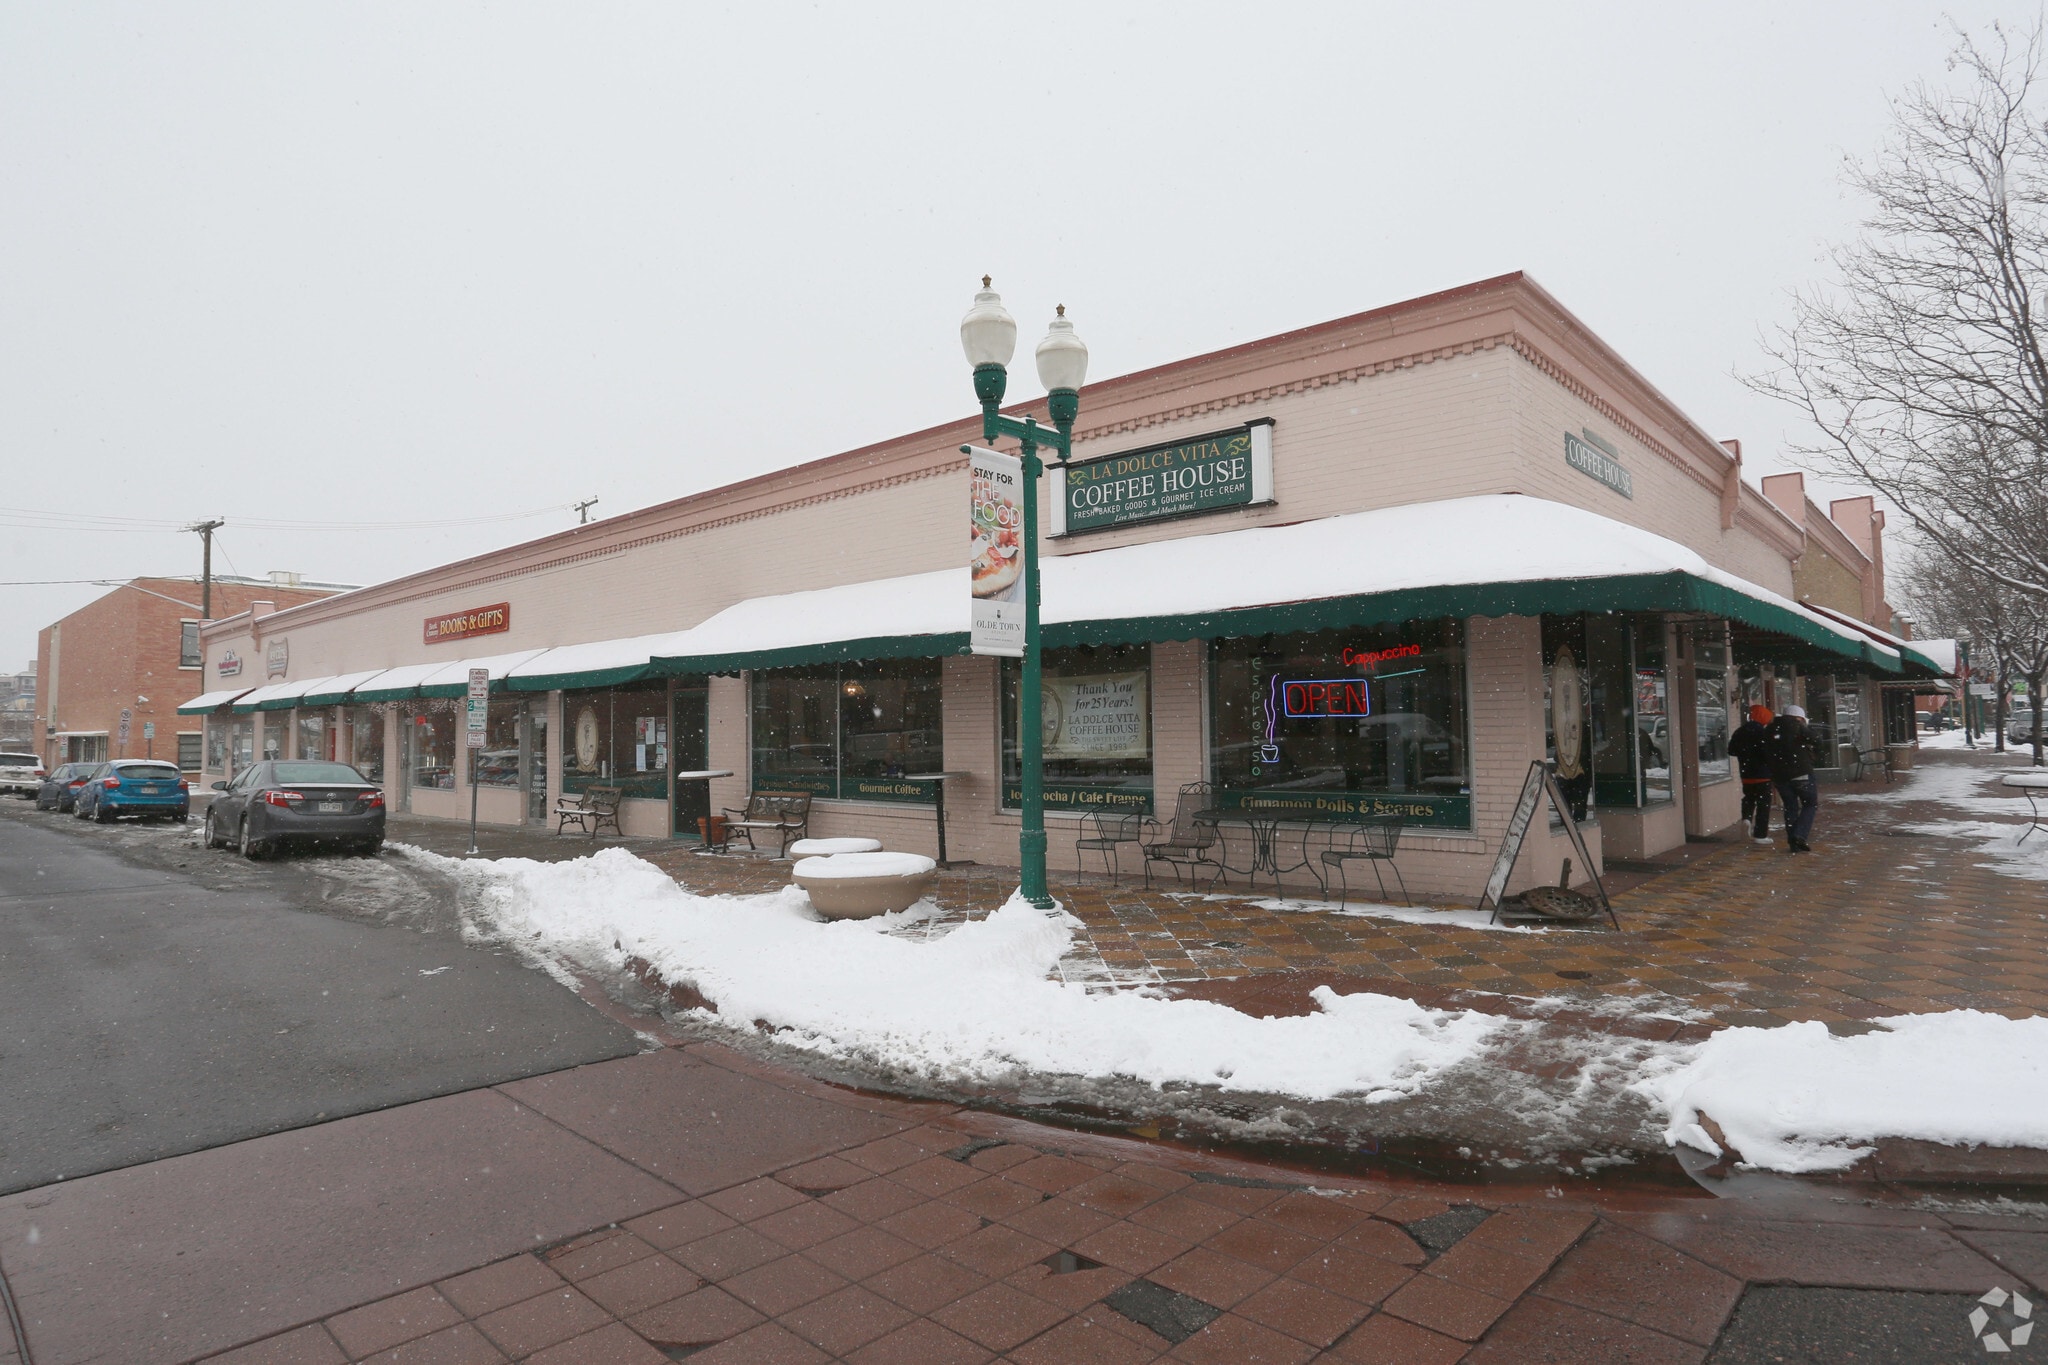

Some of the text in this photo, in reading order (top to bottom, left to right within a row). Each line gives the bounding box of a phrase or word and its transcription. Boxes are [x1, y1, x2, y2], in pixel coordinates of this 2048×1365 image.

[1091, 441, 1221, 480] LA DOLCE VITA
[1568, 439, 1631, 495] COFFEE HOUSE
[973, 467, 1013, 485] STAY FOR
[1072, 457, 1247, 509] COFFEE HOUSE
[974, 479, 999, 501] THE
[1073, 483, 1245, 520] FRESH BAKED GOODS & GOURMET ICE CREAM
[974, 499, 1021, 527] FOOD
[1114, 513, 1128, 522] Live
[1159, 505, 1178, 515] Much
[1178, 501, 1197, 512] More!
[440, 608, 503, 636] BOOKS & GIFTS
[976, 619, 1021, 632] OLDE TOWN
[1341, 643, 1421, 672] Cappuccino
[1076, 682, 1133, 695] Thank You
[1286, 682, 1367, 714] OPEN
[1073, 696, 1135, 712] for 25 Years!
[1068, 713, 1141, 724] LA DOLCE VITA
[1069, 724, 1140, 735] COFFEE HOUSE
[1081, 743, 1104, 752] SINCE
[859, 783, 921, 795] Gourmet Coffee
[1043, 790, 1068, 802] ocha
[1079, 791, 1103, 804] Cafe
[1358, 800, 1370, 814] &
